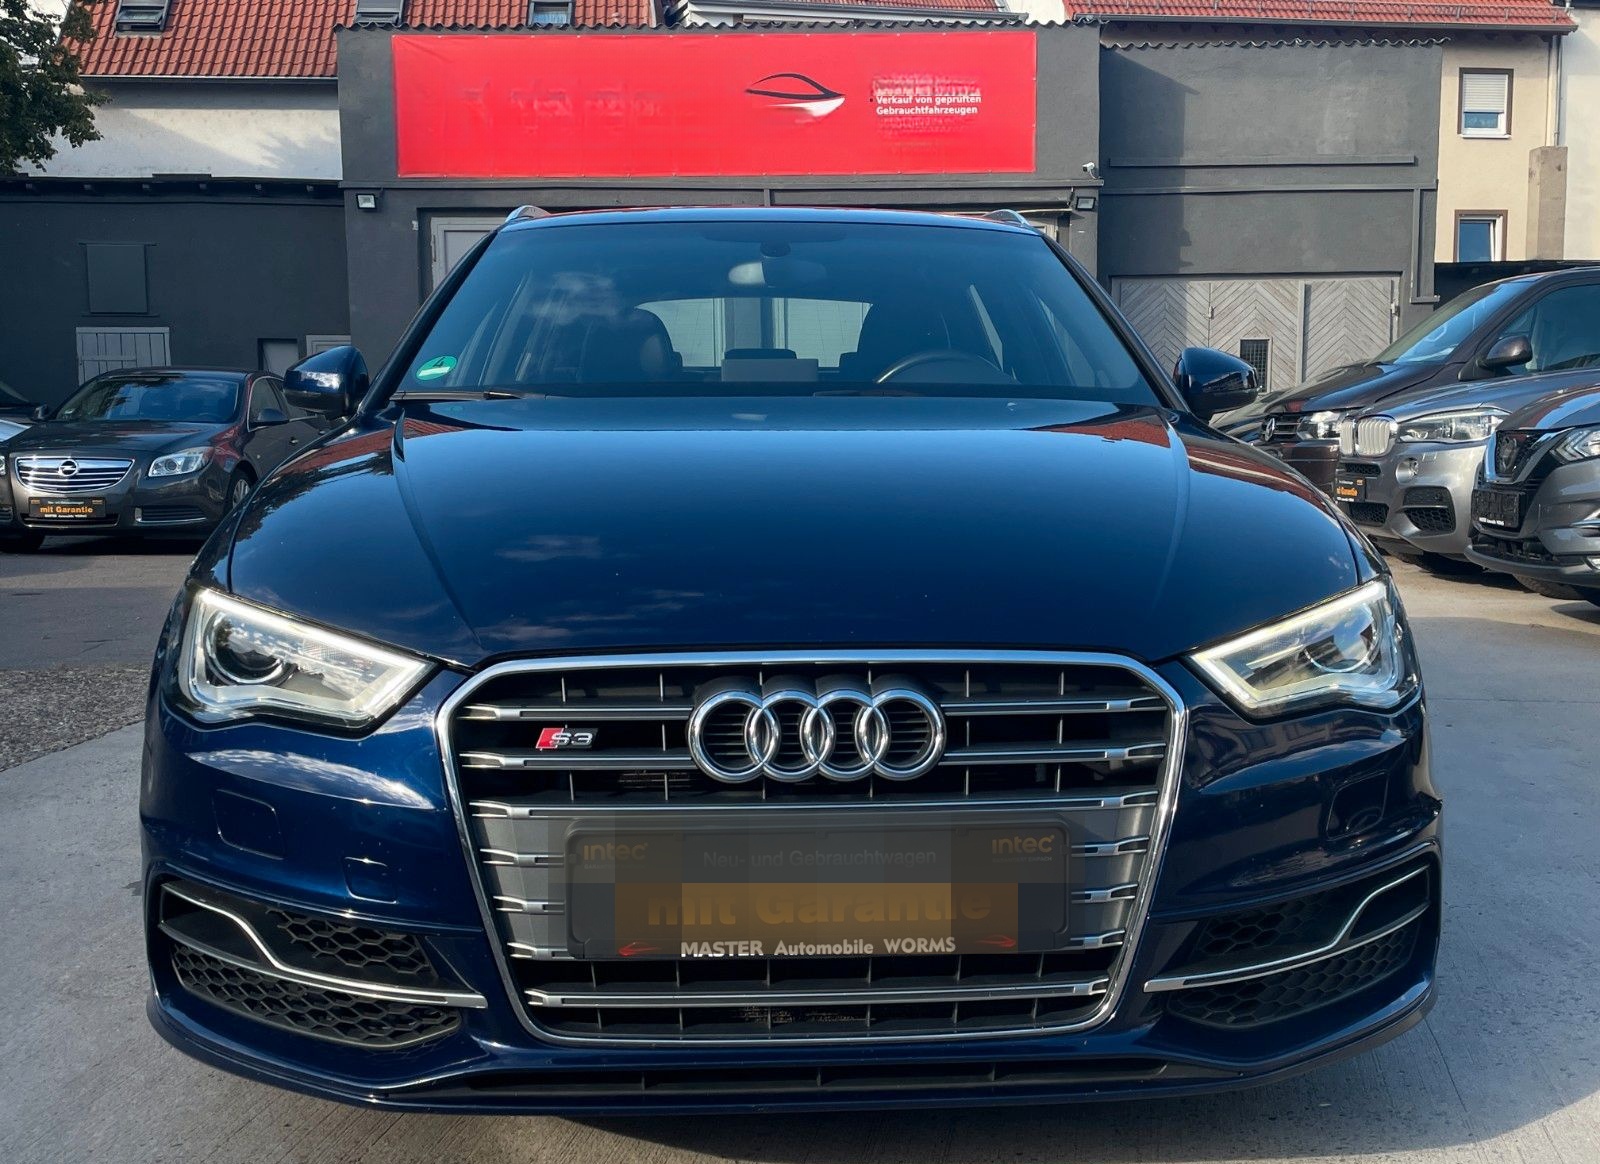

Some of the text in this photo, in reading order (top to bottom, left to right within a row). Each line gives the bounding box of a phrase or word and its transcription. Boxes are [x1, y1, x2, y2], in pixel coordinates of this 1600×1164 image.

[876, 95, 913, 104] Verkauf
[915, 96, 933, 104] von
[876, 106, 978, 116] Gebrauchtfahrzeugen
[40, 505, 93, 513] mit Garantie
[549, 732, 593, 746] S3
[703, 847, 937, 868] Neu- und Gebrauchtwagen
[755, 887, 993, 925] Garantie
[680, 936, 957, 958] MASTER Automobile WORMS
